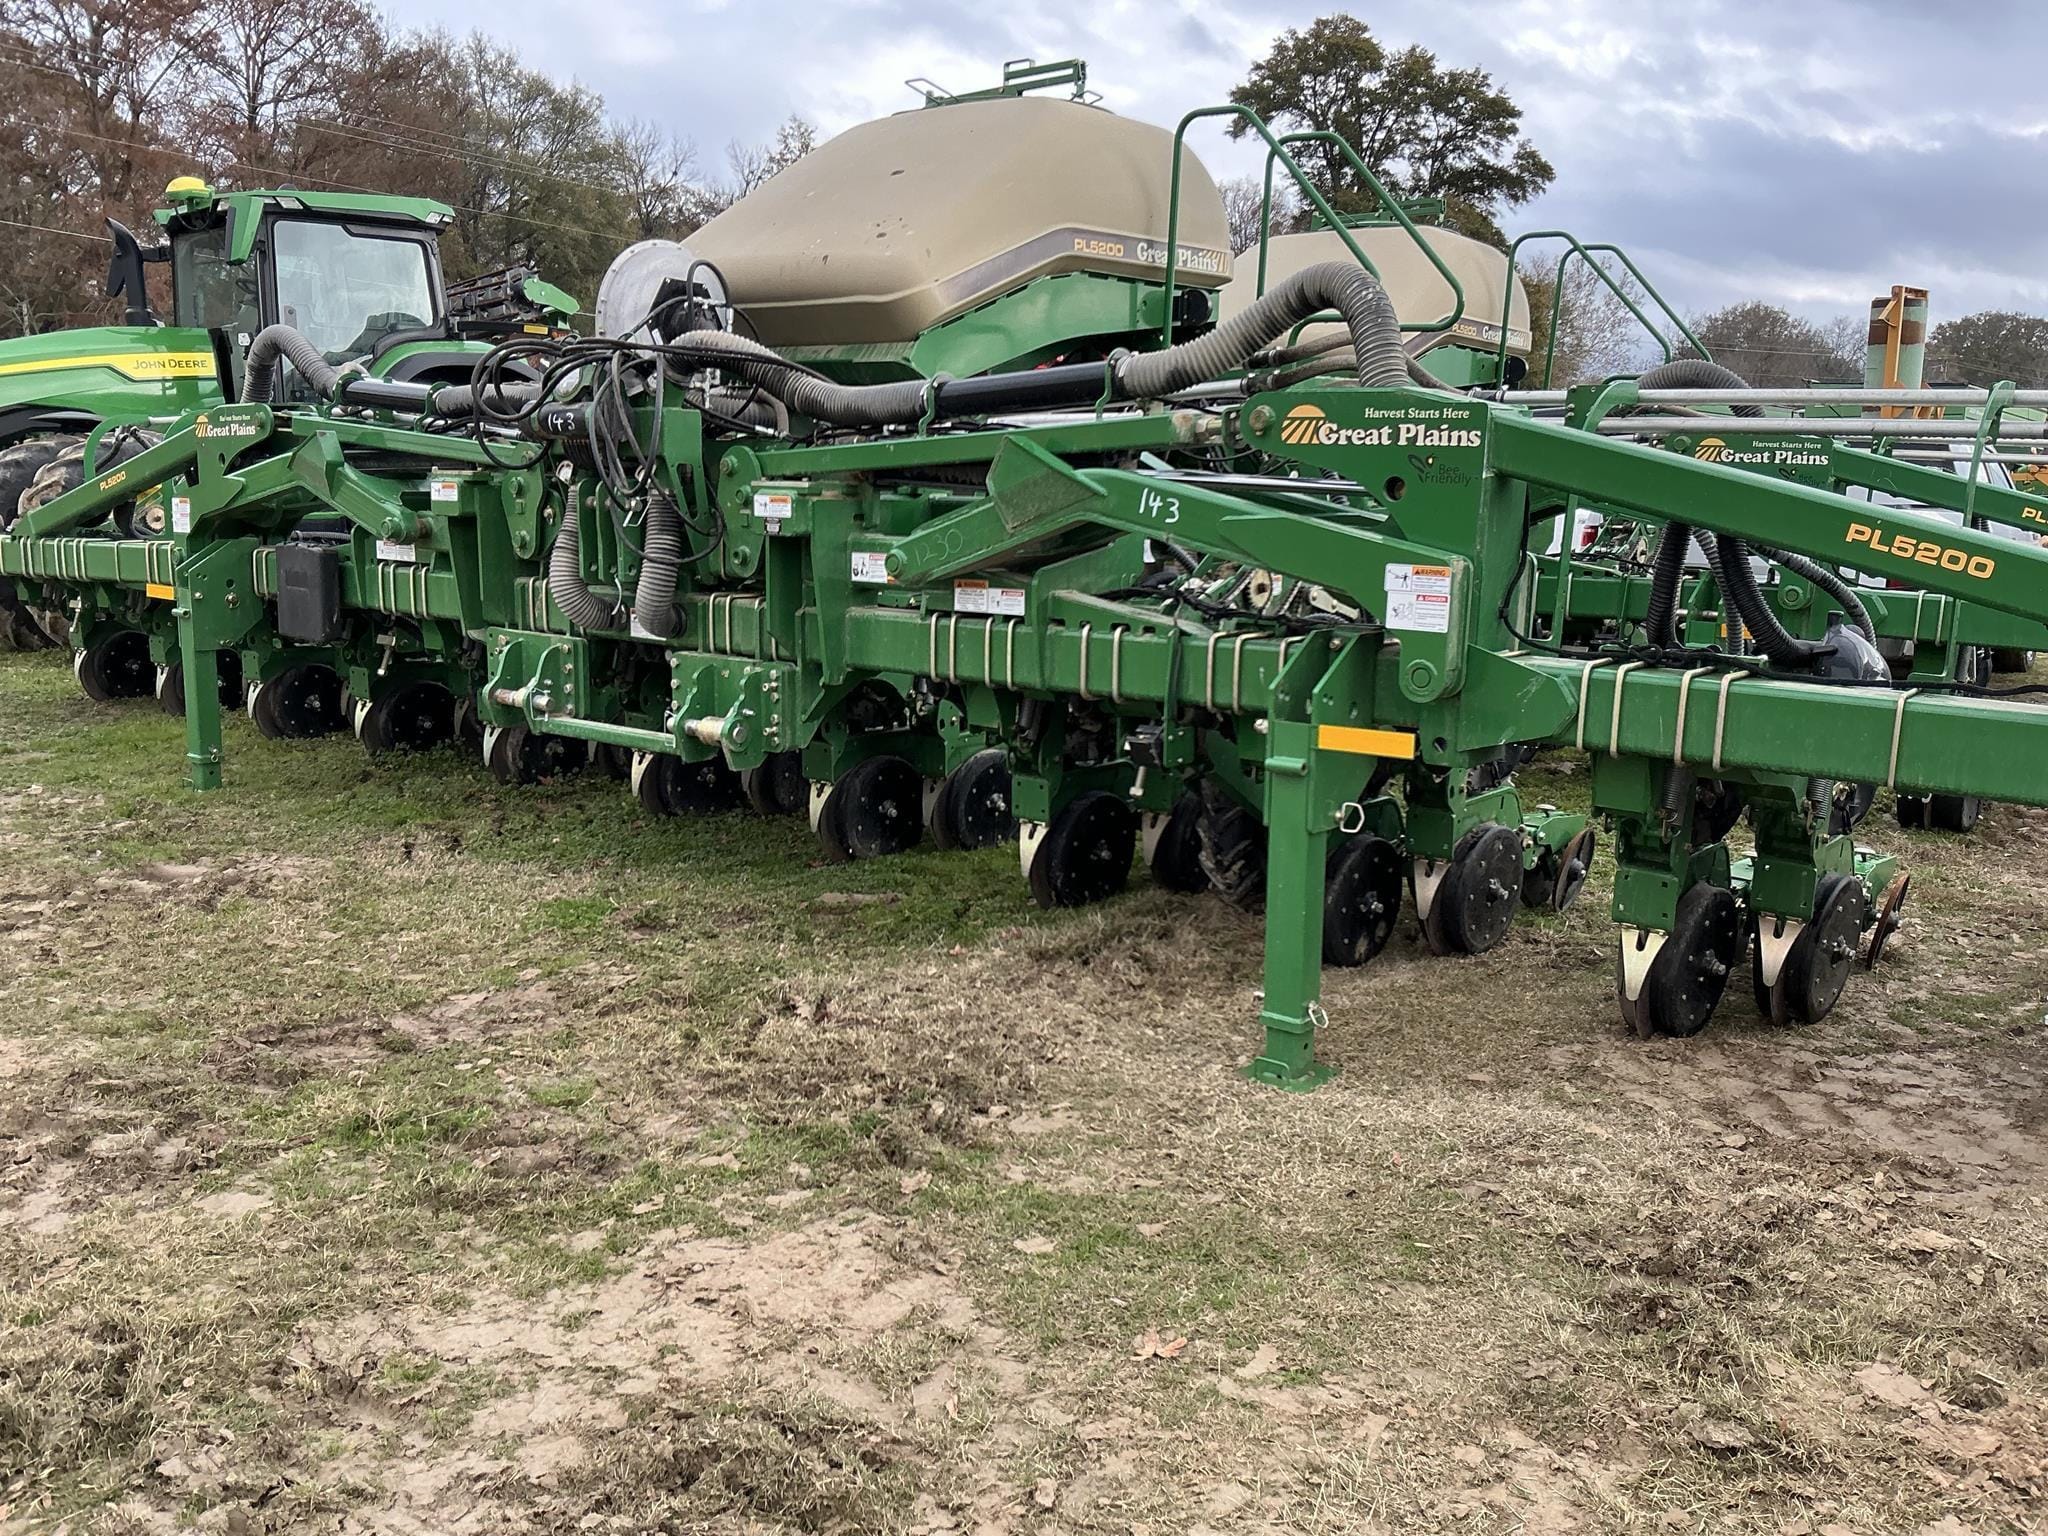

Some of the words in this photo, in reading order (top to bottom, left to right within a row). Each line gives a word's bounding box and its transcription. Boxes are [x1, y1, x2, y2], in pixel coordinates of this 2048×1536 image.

[1074, 237, 1125, 257] PL5200
[1137, 242, 1169, 264] Grea
[1177, 249, 1218, 272] Plains
[133, 359, 167, 370] JOHN
[167, 358, 208, 369] DEERE
[547, 412, 576, 432] 143
[1364, 407, 1405, 419] Harvest
[1407, 407, 1440, 419] Starts
[1442, 407, 1470, 419] Here
[207, 424, 230, 437] Great
[230, 423, 256, 436] Plains
[1318, 422, 1393, 446] Great
[1397, 422, 1482, 448] Plains
[1752, 440, 1780, 449] Harvest
[1781, 440, 1802, 449] Starts
[1803, 441, 1822, 450] Here
[1720, 448, 1771, 464] Great
[1773, 449, 1829, 466] Plains
[100, 471, 126, 491] PL5200
[1424, 471, 1472, 487] Friendly
[1139, 487, 1180, 524] 143
[2021, 507, 2048, 523] PL
[1845, 522, 1996, 580] PL5200
